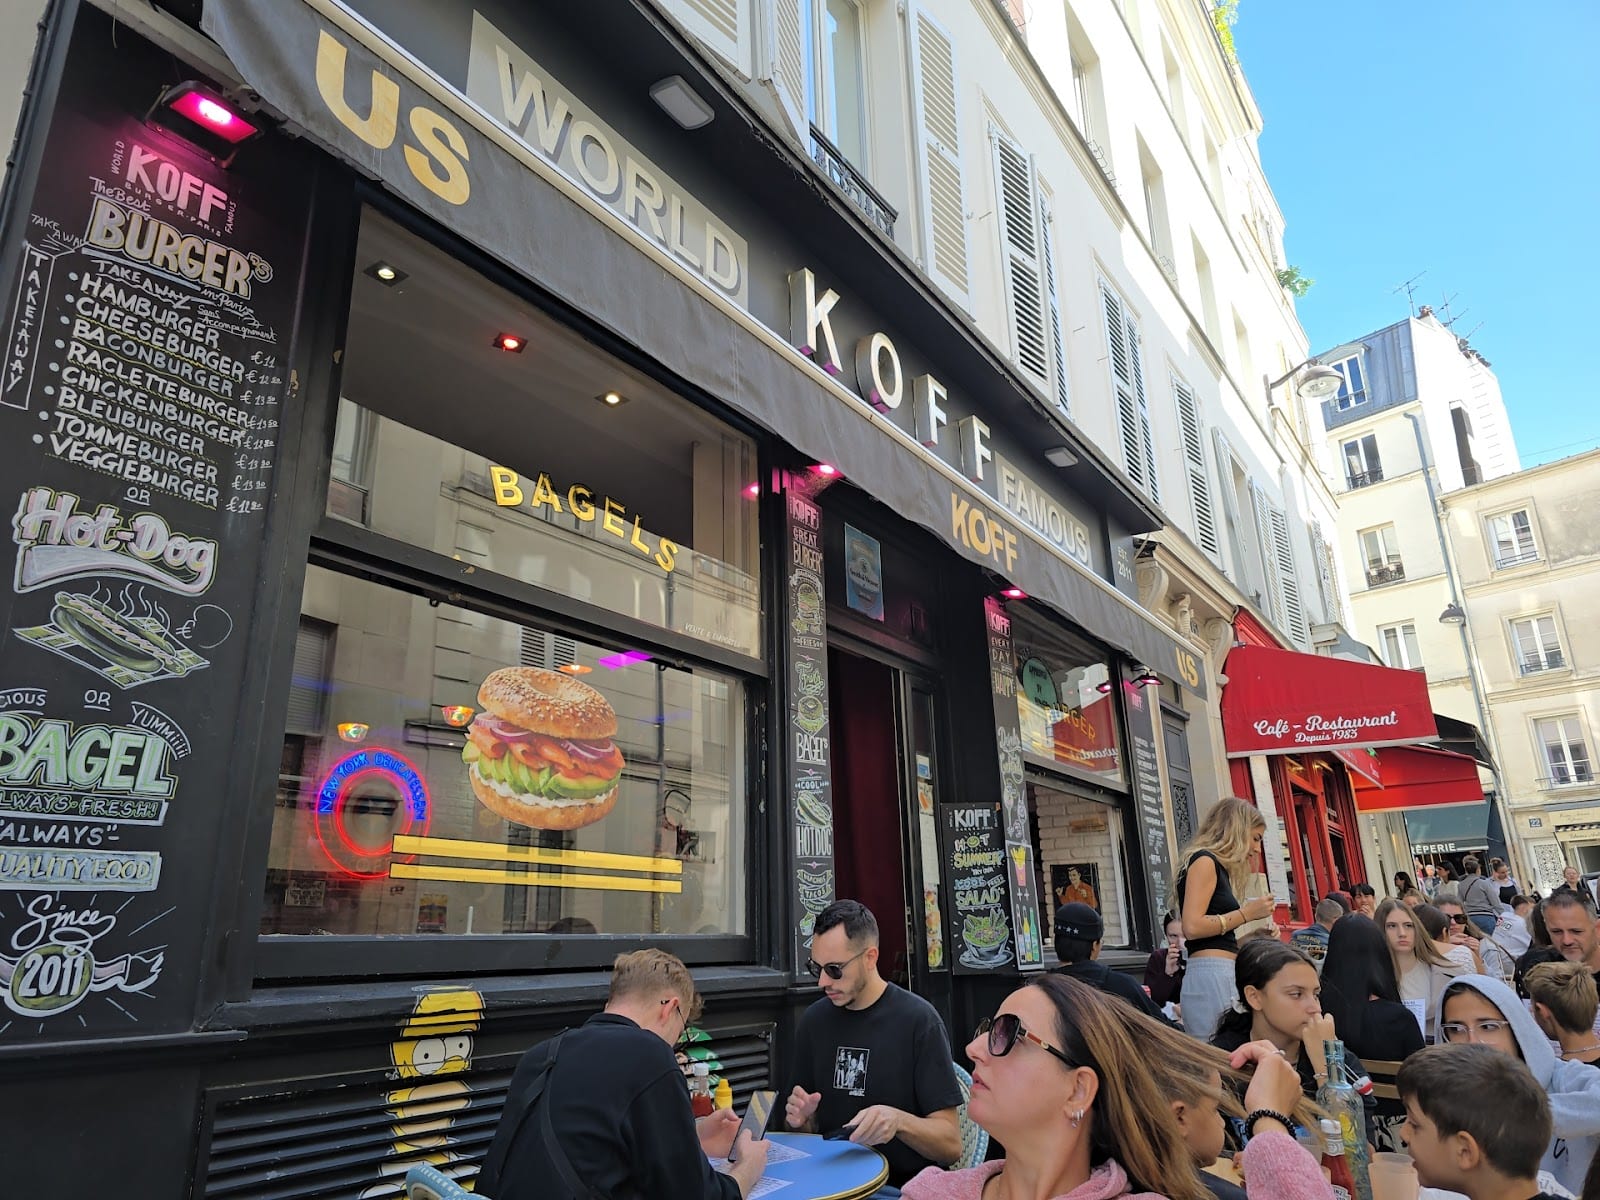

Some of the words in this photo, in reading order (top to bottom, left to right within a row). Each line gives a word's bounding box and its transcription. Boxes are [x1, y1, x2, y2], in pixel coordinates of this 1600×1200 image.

[316, 29, 470, 205] US
[111, 140, 125, 175] WORLD
[496, 45, 739, 292] WORLD
[90, 177, 114, 197] The
[114, 183, 151, 211] Best
[127, 145, 228, 222] KOFF
[31, 214, 60, 230] TAKE
[224, 201, 237, 234] FAMOUS
[91, 259, 141, 282] TAKE
[143, 279, 192, 309] AWAY
[201, 287, 218, 300] in
[218, 293, 254, 315] Paris
[80, 272, 220, 350] HAMBURGER
[73, 318, 233, 397] BACONBURGER
[76, 297, 245, 381] CHEESEBURGER
[67, 341, 249, 428] RACLETTEBURGER
[788, 267, 991, 483] KOFF
[57, 386, 205, 455] BLEUBURGER
[62, 366, 242, 448] CHICKENBURGER
[50, 434, 219, 506] VEGGIEBURGER
[54, 411, 218, 484] TOMMEBURGER
[126, 486, 150, 503] OR
[1001, 466, 1088, 563] FAMOUS
[489, 464, 678, 573] BAGELS
[793, 527, 818, 548] GREAT
[951, 492, 1019, 574] KOFF
[1118, 561, 1133, 583] 2011
[990, 611, 1011, 637] KOFF
[992, 648, 1011, 663] DAY
[1176, 646, 1199, 688] US
[84, 689, 111, 708] OR
[1254, 719, 1290, 738] Café
[1305, 711, 1398, 731] Restaurant
[1295, 731, 1330, 744] Depuis
[1332, 728, 1358, 741] 1983
[0, 715, 172, 795] BAGEL
[319, 776, 340, 813] NEW
[339, 753, 368, 777] YORK
[954, 808, 991, 828] KOFF
[92, 859, 151, 880] FOOD
[805, 886, 826, 900] TACOS
[19, 953, 85, 997] 2011
